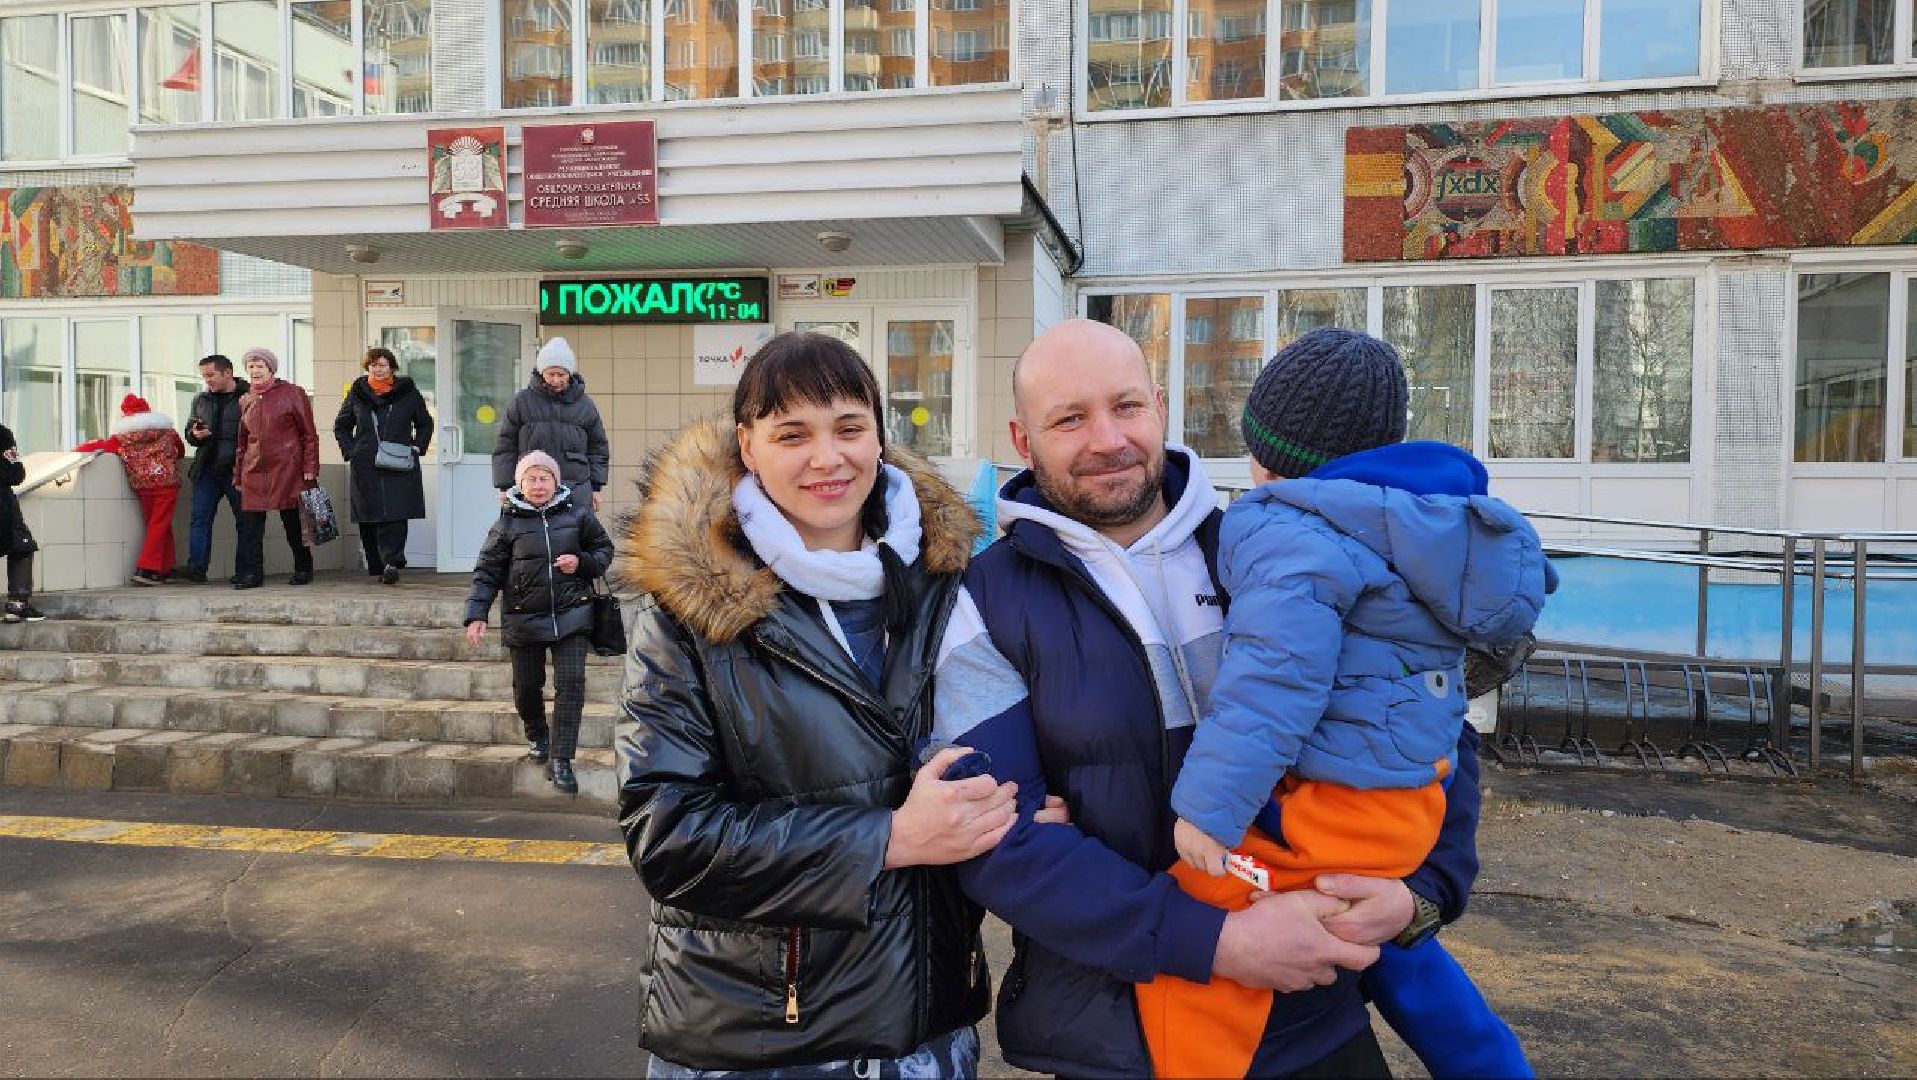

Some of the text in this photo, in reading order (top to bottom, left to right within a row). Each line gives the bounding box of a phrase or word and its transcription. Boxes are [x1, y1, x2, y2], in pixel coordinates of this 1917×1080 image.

[530, 195, 580, 209] СРЕДНЯЯ
[584, 194, 625, 207] ШКОЛА
[708, 303, 761, 320] 11:04
[698, 355, 729, 363] ТОЧКА
